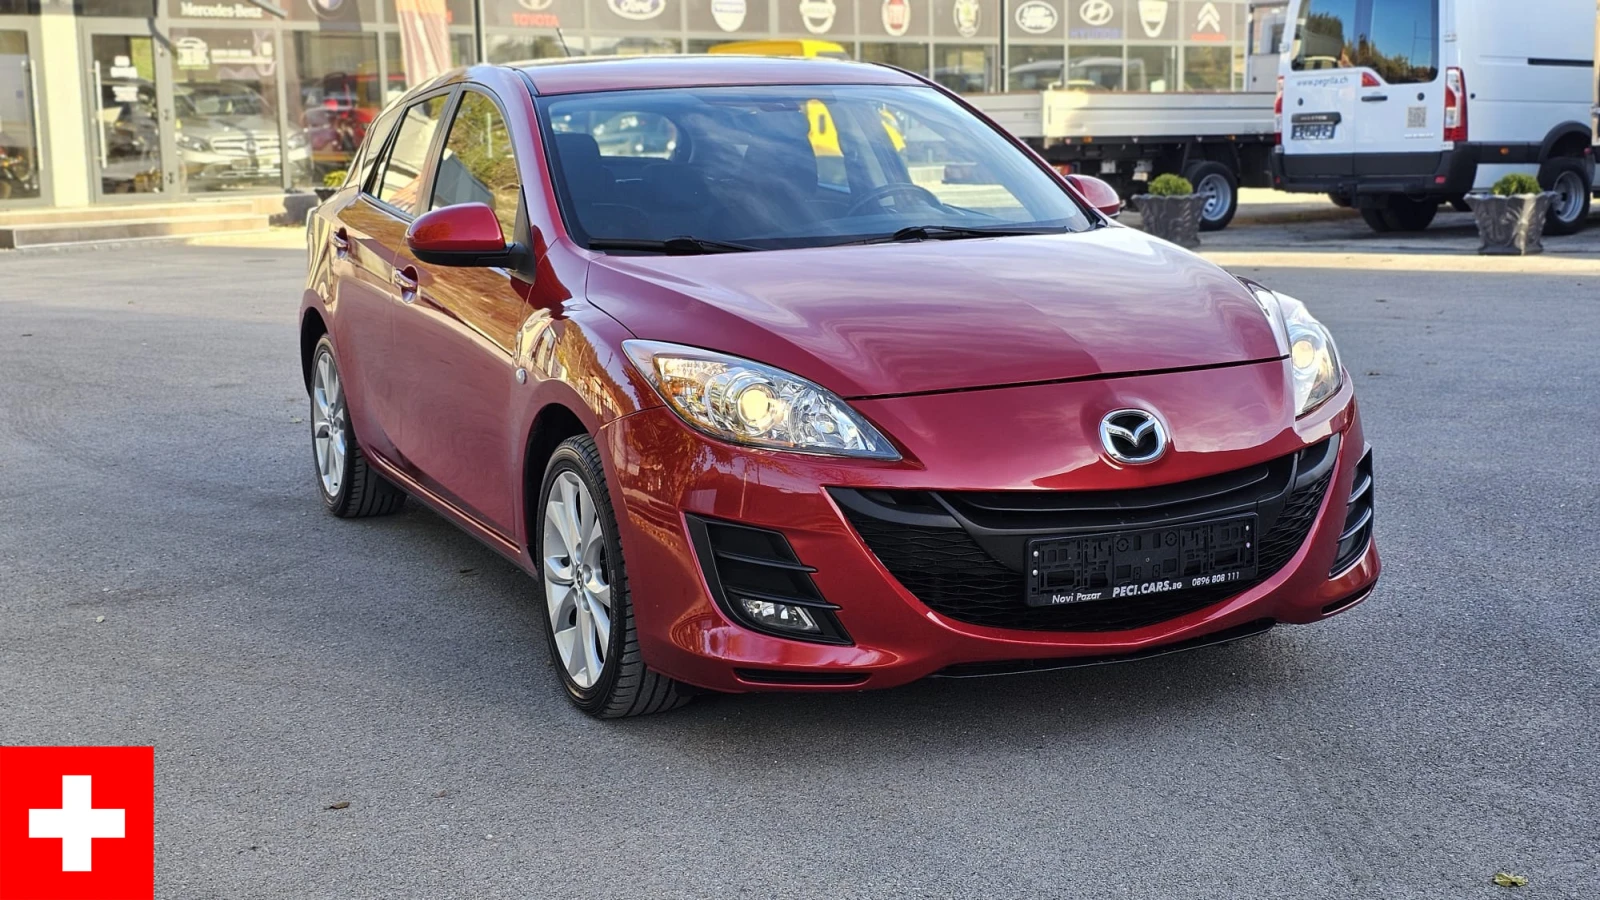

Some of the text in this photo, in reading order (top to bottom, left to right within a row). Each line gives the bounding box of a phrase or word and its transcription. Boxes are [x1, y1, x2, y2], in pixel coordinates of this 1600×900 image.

[181, 1, 262, 18] Mercedes-Benz
[512, 12, 559, 27] TOYOTA
[1052, 593, 1074, 604] Novi
[1076, 592, 1102, 602] Pazar
[1192, 577, 1210, 587] 0896
[1211, 574, 1226, 584] 808
[1227, 571, 1240, 581] 111
